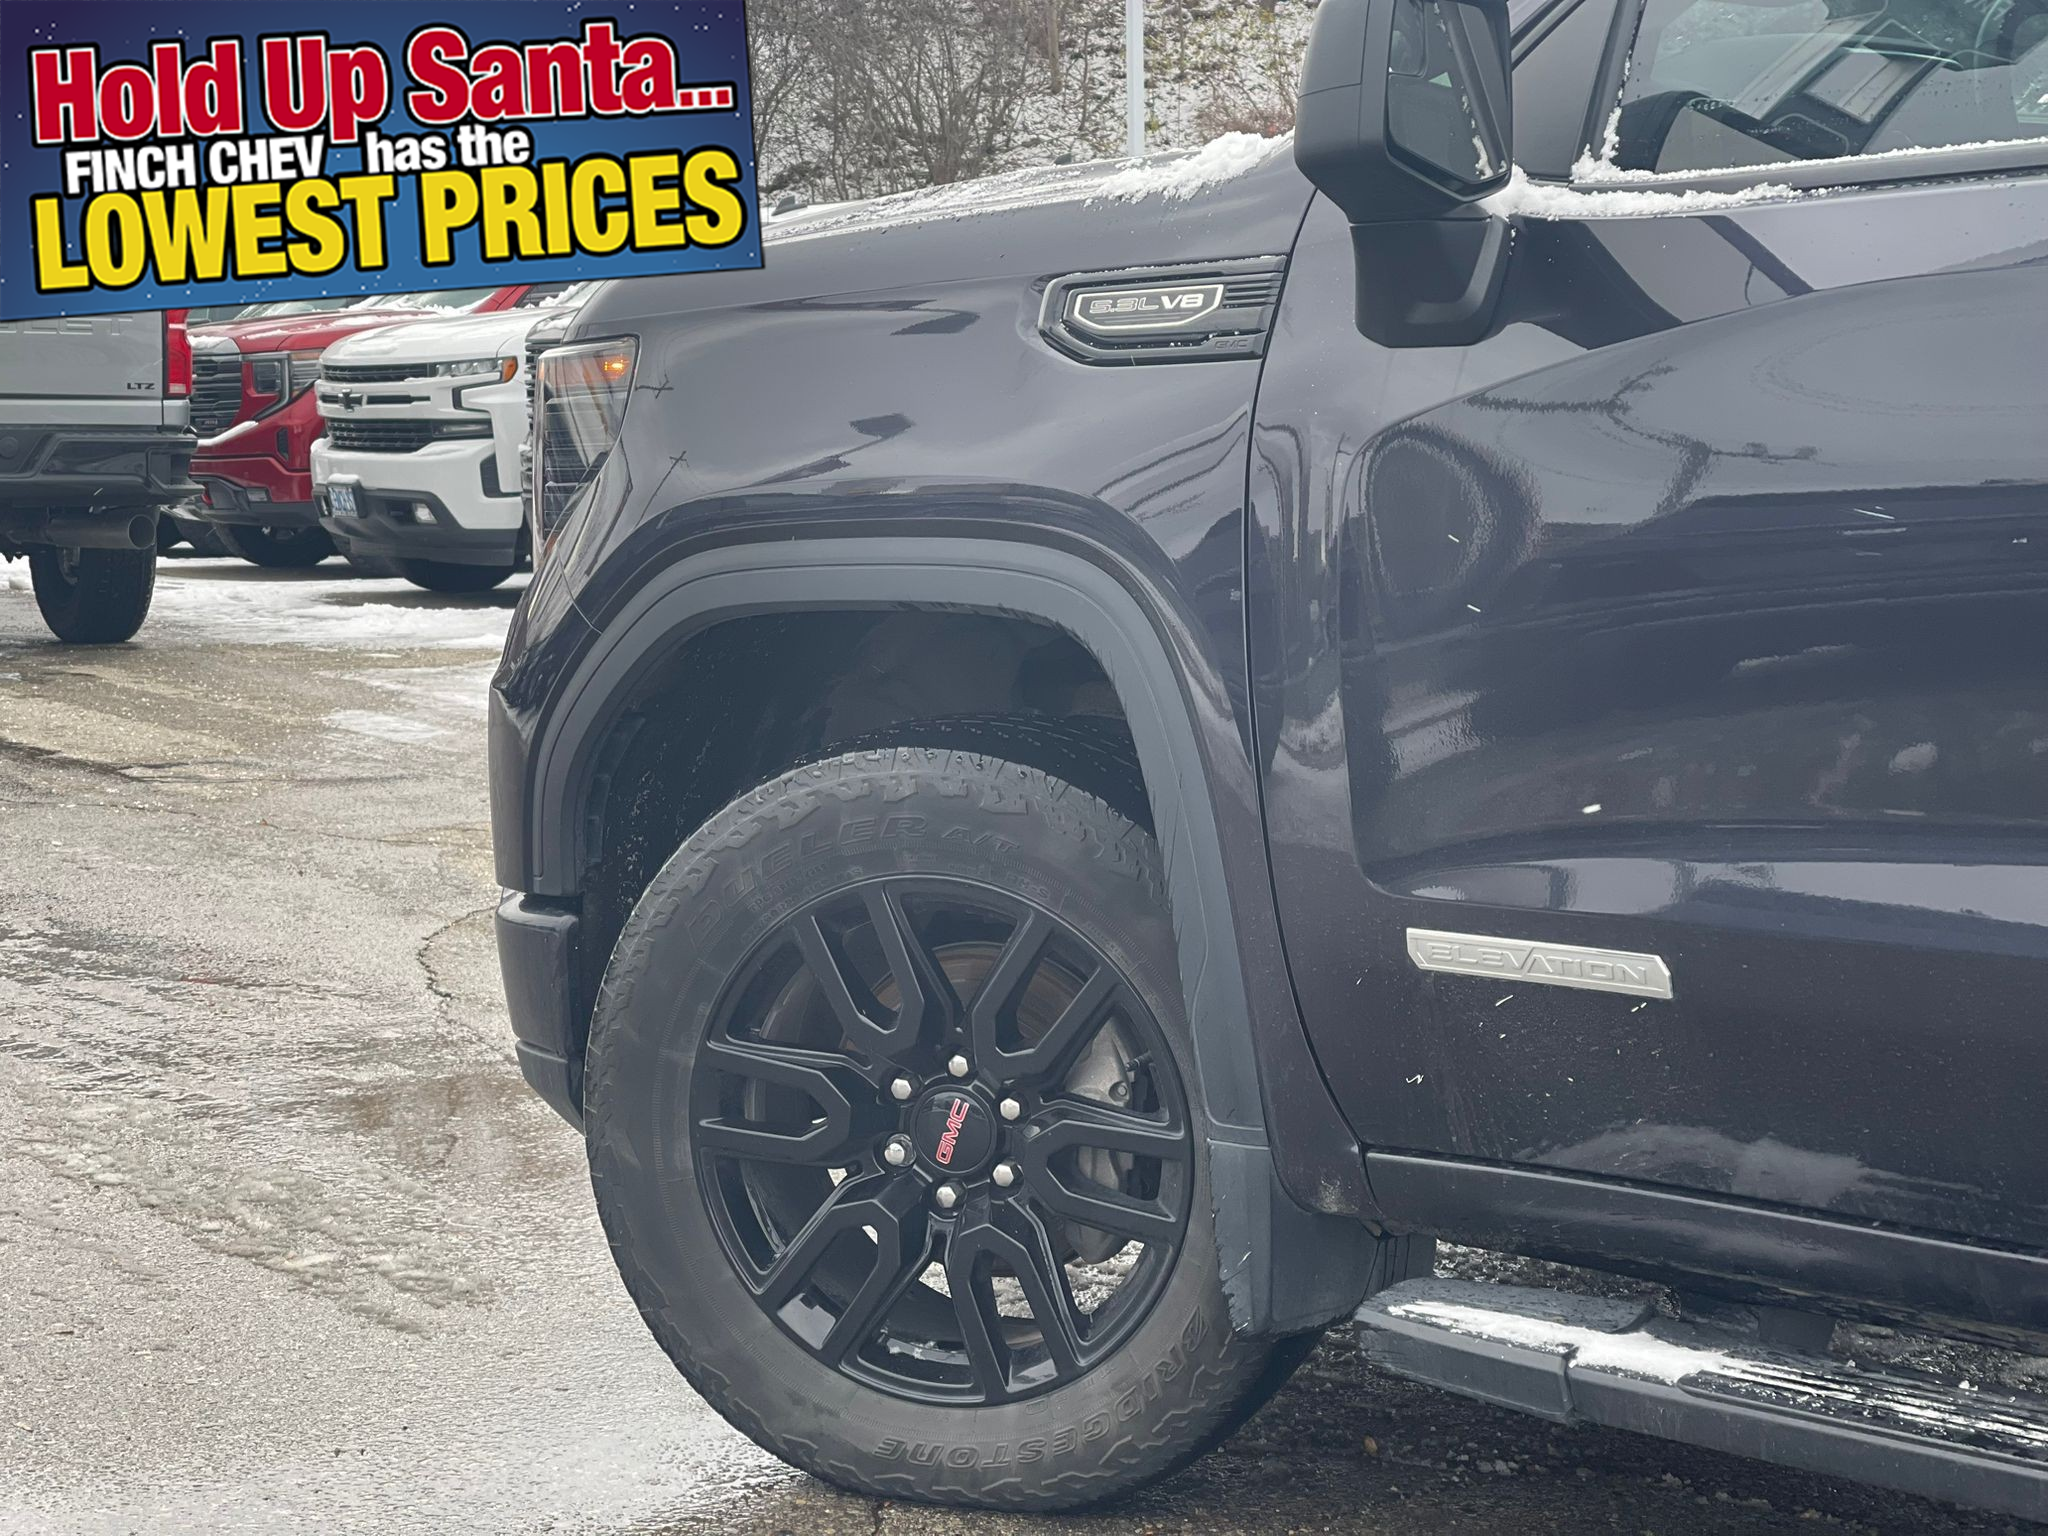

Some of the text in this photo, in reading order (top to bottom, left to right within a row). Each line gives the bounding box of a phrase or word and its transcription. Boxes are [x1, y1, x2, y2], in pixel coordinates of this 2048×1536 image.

[1215, 338, 1248, 350] GMC
[126, 382, 156, 391] LTZ
[687, 813, 1021, 950] DUELER A/T
[1425, 941, 1648, 985] ELEVATION
[936, 1098, 970, 1165] GMC
[871, 1304, 1209, 1469] BRIDGESTONE
